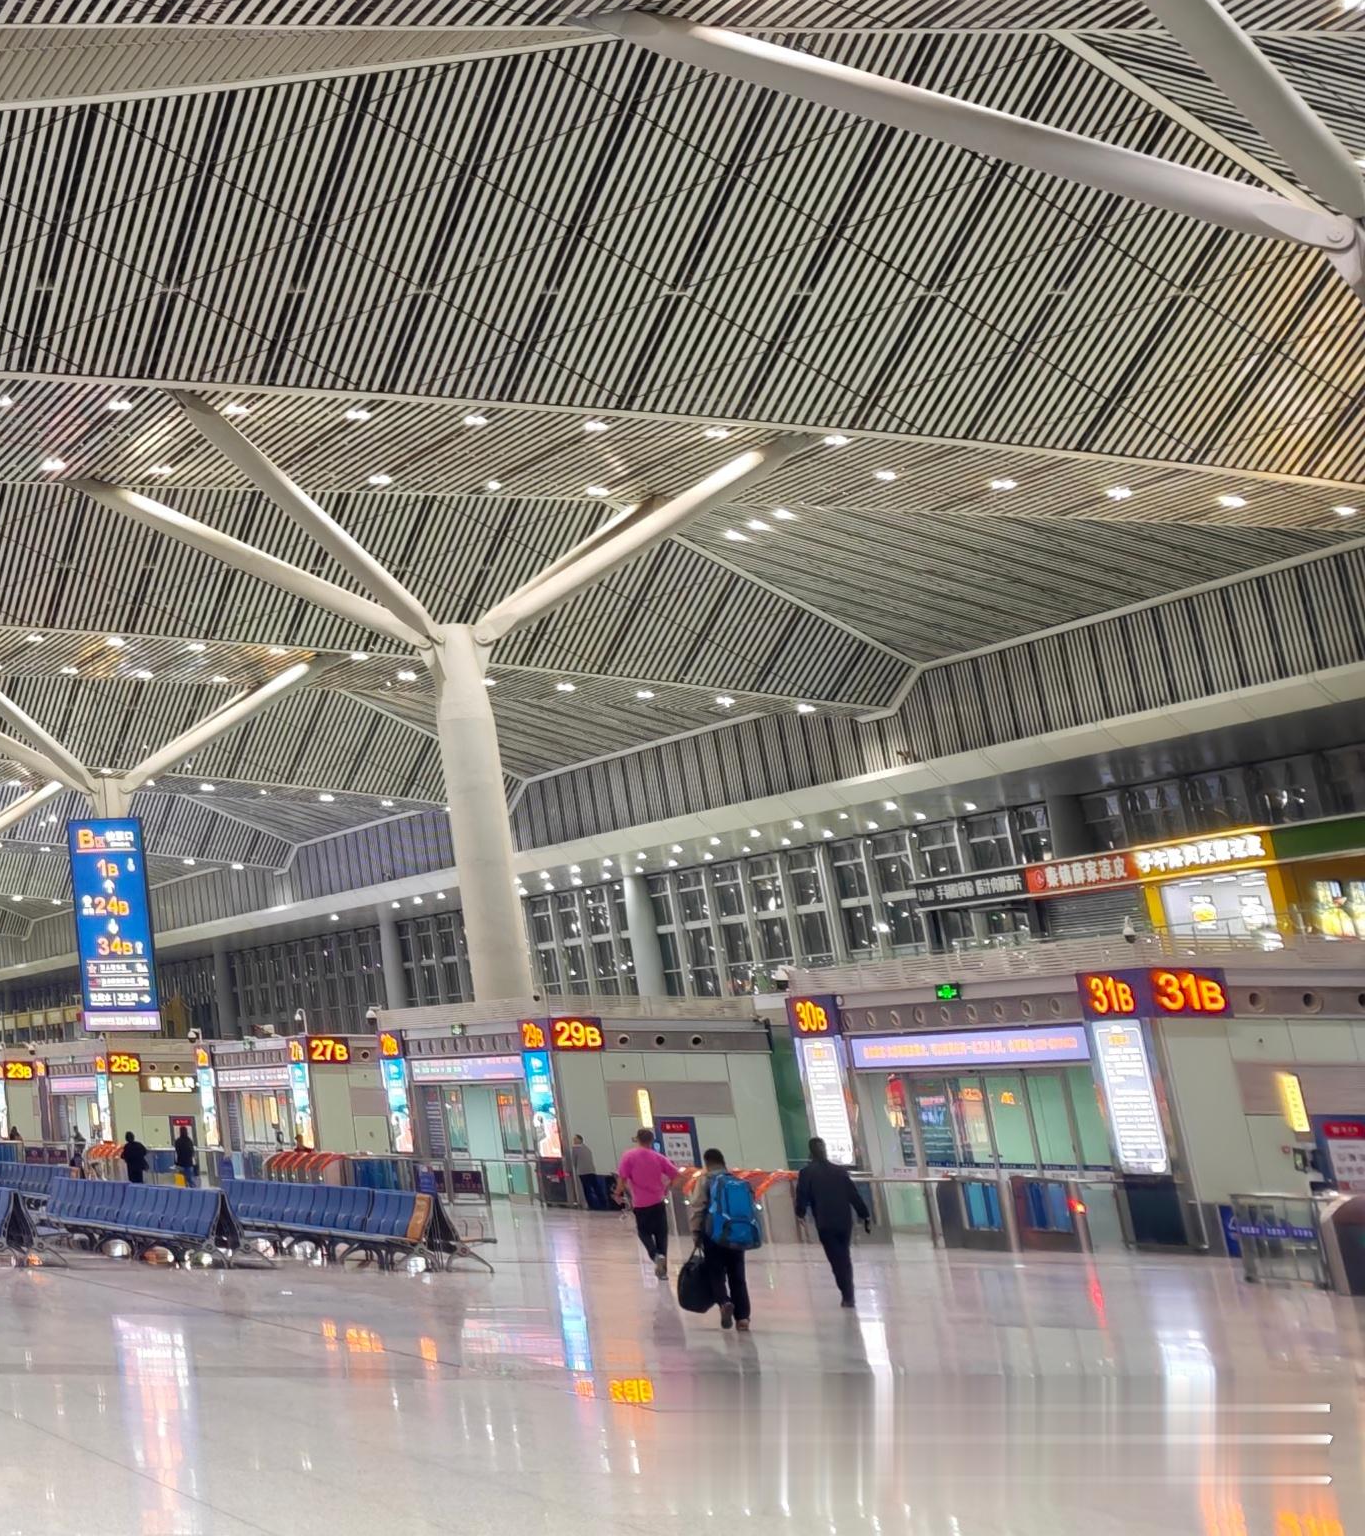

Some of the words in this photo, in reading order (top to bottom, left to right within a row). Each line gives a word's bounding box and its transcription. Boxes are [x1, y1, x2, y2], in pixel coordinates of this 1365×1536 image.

[97, 859, 119, 877] 1B
[94, 896, 129, 915] 24B
[98, 937, 133, 955] 34B
[1089, 976, 1135, 1014] 31B
[1156, 972, 1226, 1012] 31B
[796, 1001, 829, 1033] 30B
[522, 1022, 545, 1048] 29B
[555, 1021, 603, 1047] 29B
[311, 1039, 348, 1061] 27B
[6, 1063, 33, 1079] 23B
[111, 1055, 140, 1073] 25B
